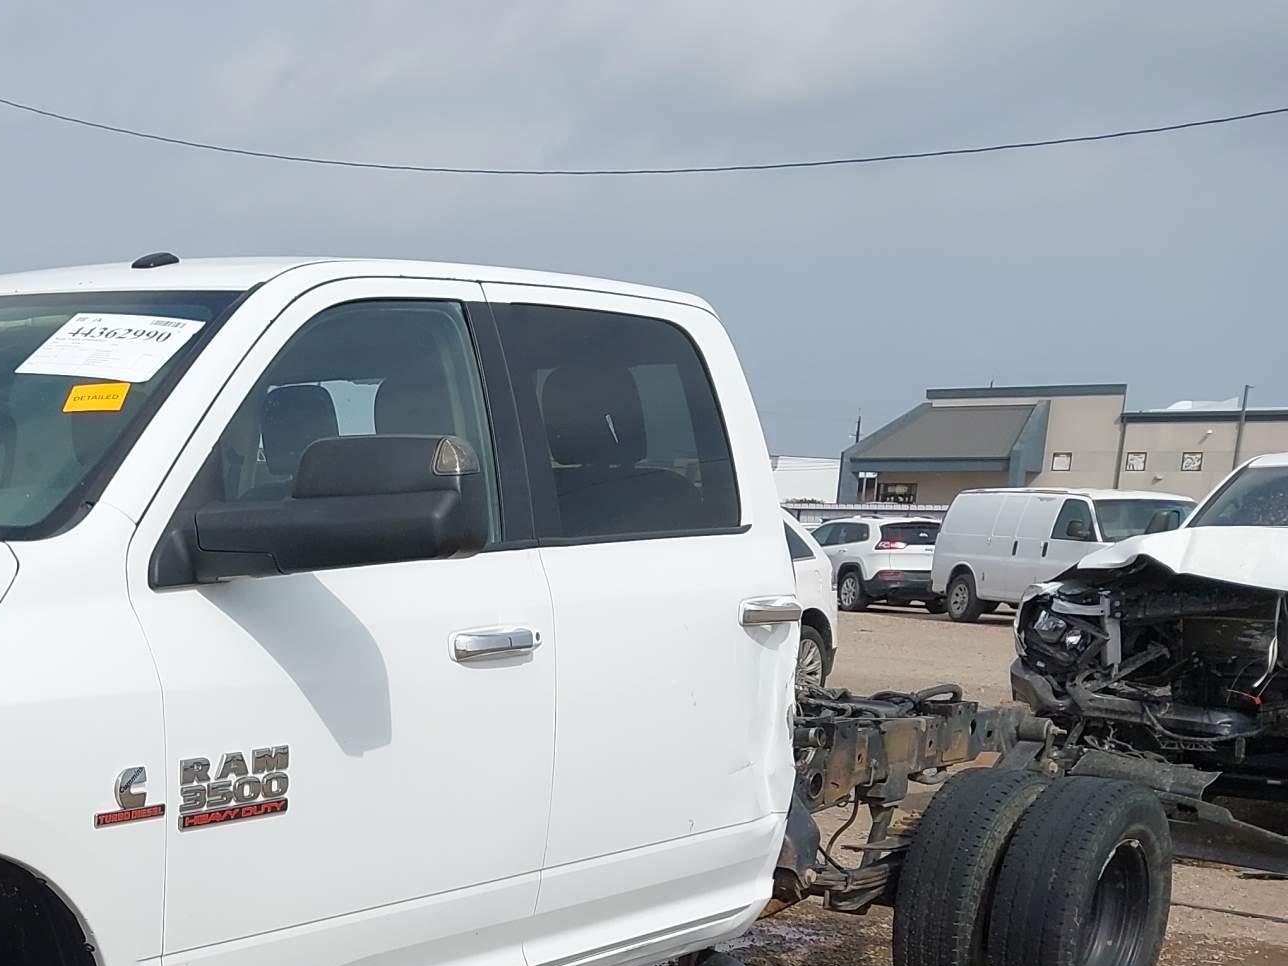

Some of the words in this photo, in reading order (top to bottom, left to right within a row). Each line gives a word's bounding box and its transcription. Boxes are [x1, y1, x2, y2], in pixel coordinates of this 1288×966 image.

[68, 326, 172, 343] 44362990
[72, 394, 120, 402] DETAILED
[179, 745, 289, 786] RAM
[179, 772, 289, 814] 3500
[99, 810, 131, 825] TURBO
[131, 805, 164, 820] DIESEL
[184, 809, 241, 828] HEAVY
[241, 799, 286, 818] DUTY
